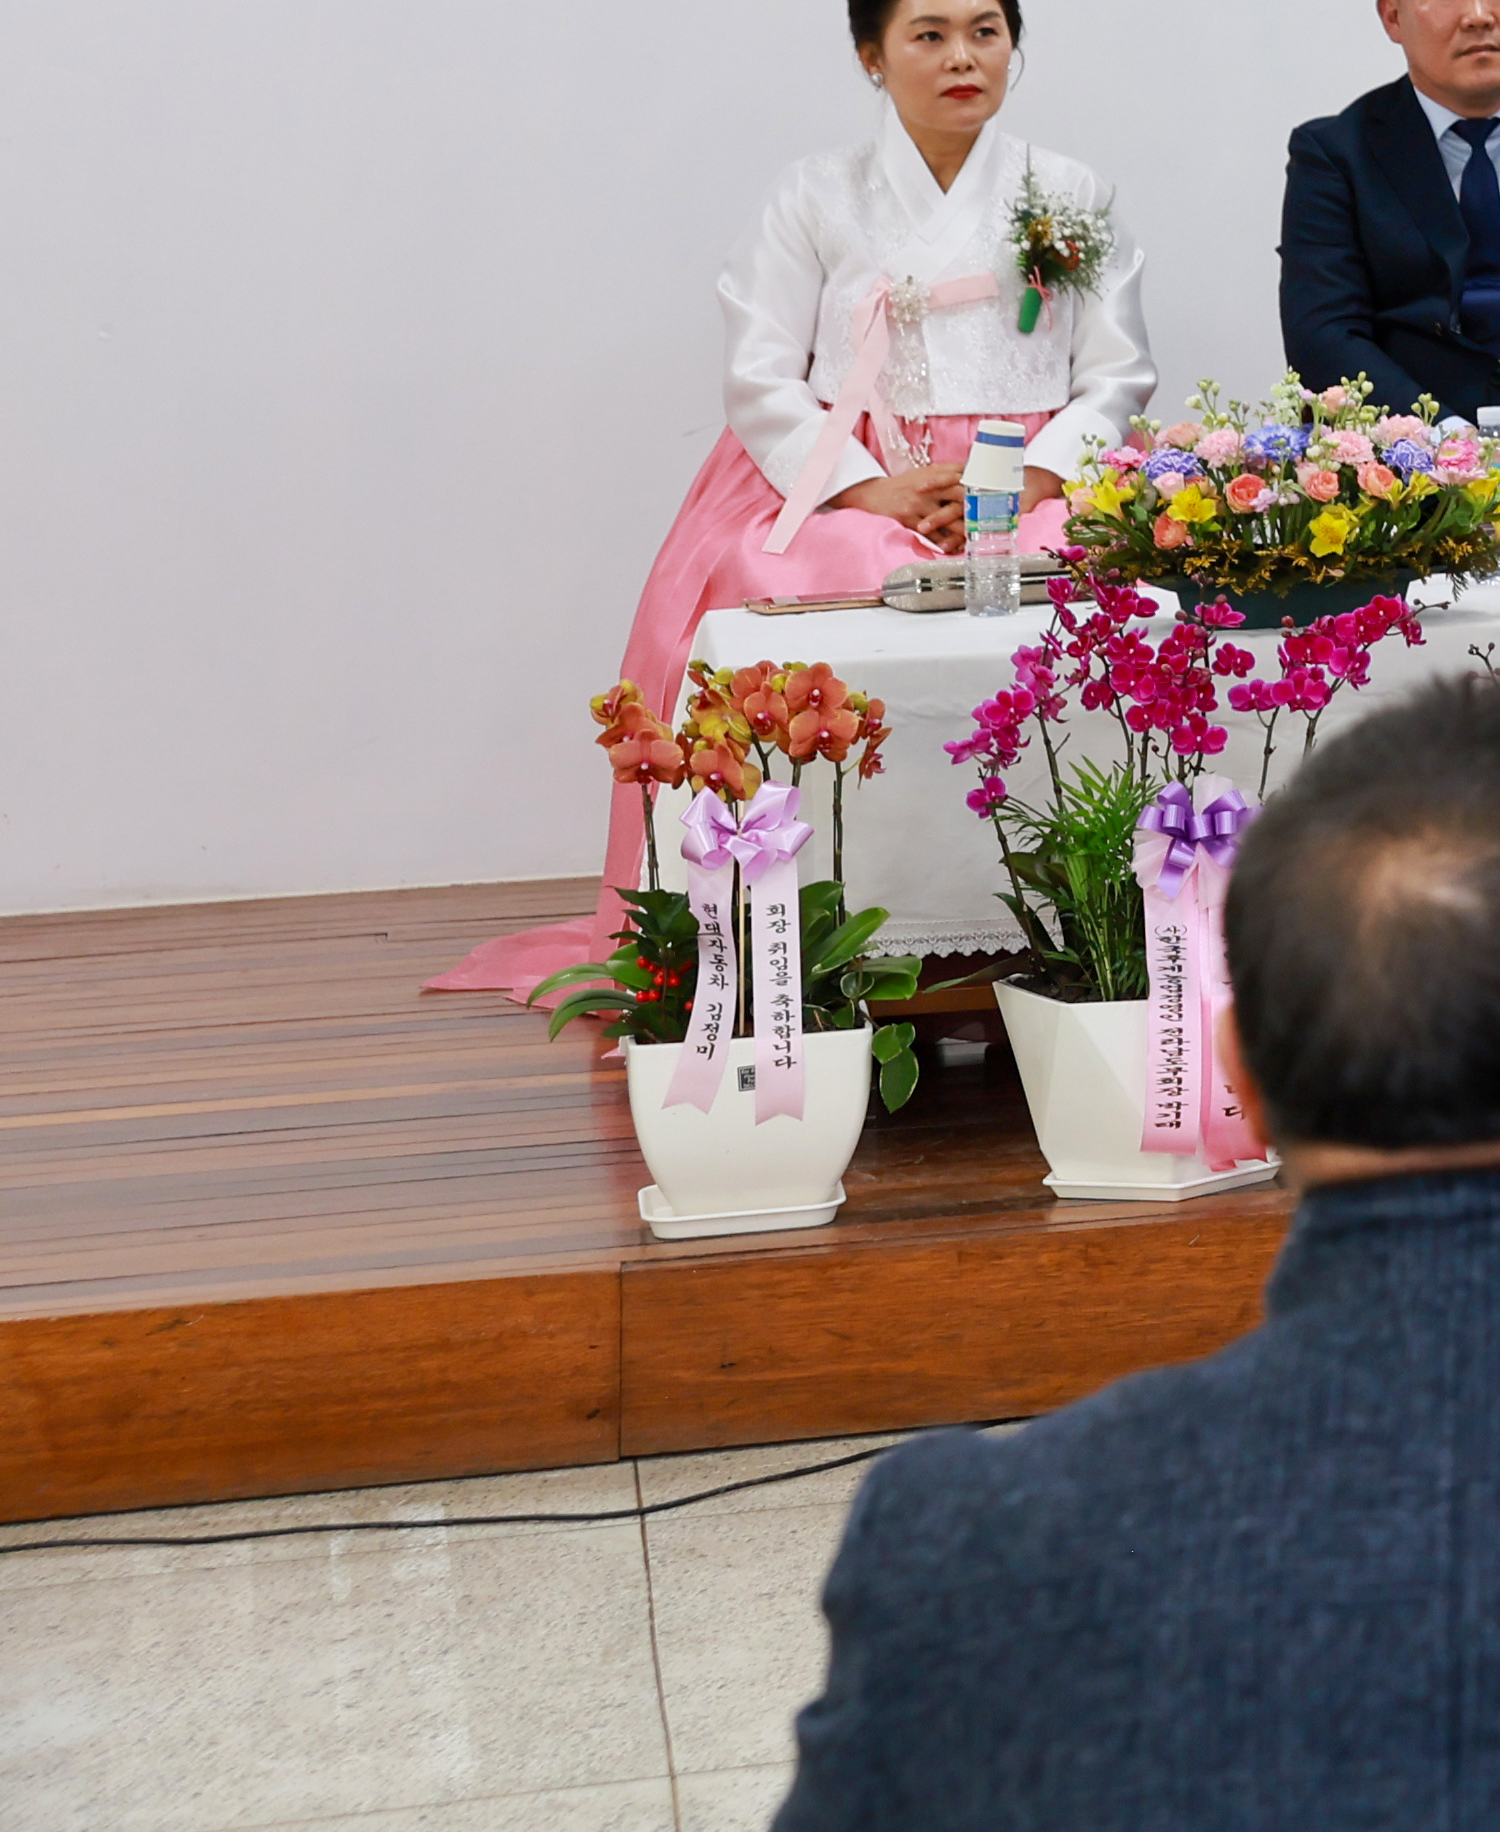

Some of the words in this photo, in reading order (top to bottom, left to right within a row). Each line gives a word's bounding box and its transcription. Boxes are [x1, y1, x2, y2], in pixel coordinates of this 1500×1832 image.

[701, 902, 730, 991] 현대자동차
[766, 903, 791, 934] 회장
[767, 940, 793, 987] 취임을
[696, 1001, 724, 1061] 김정미
[770, 993, 797, 1070] 축하합니다
